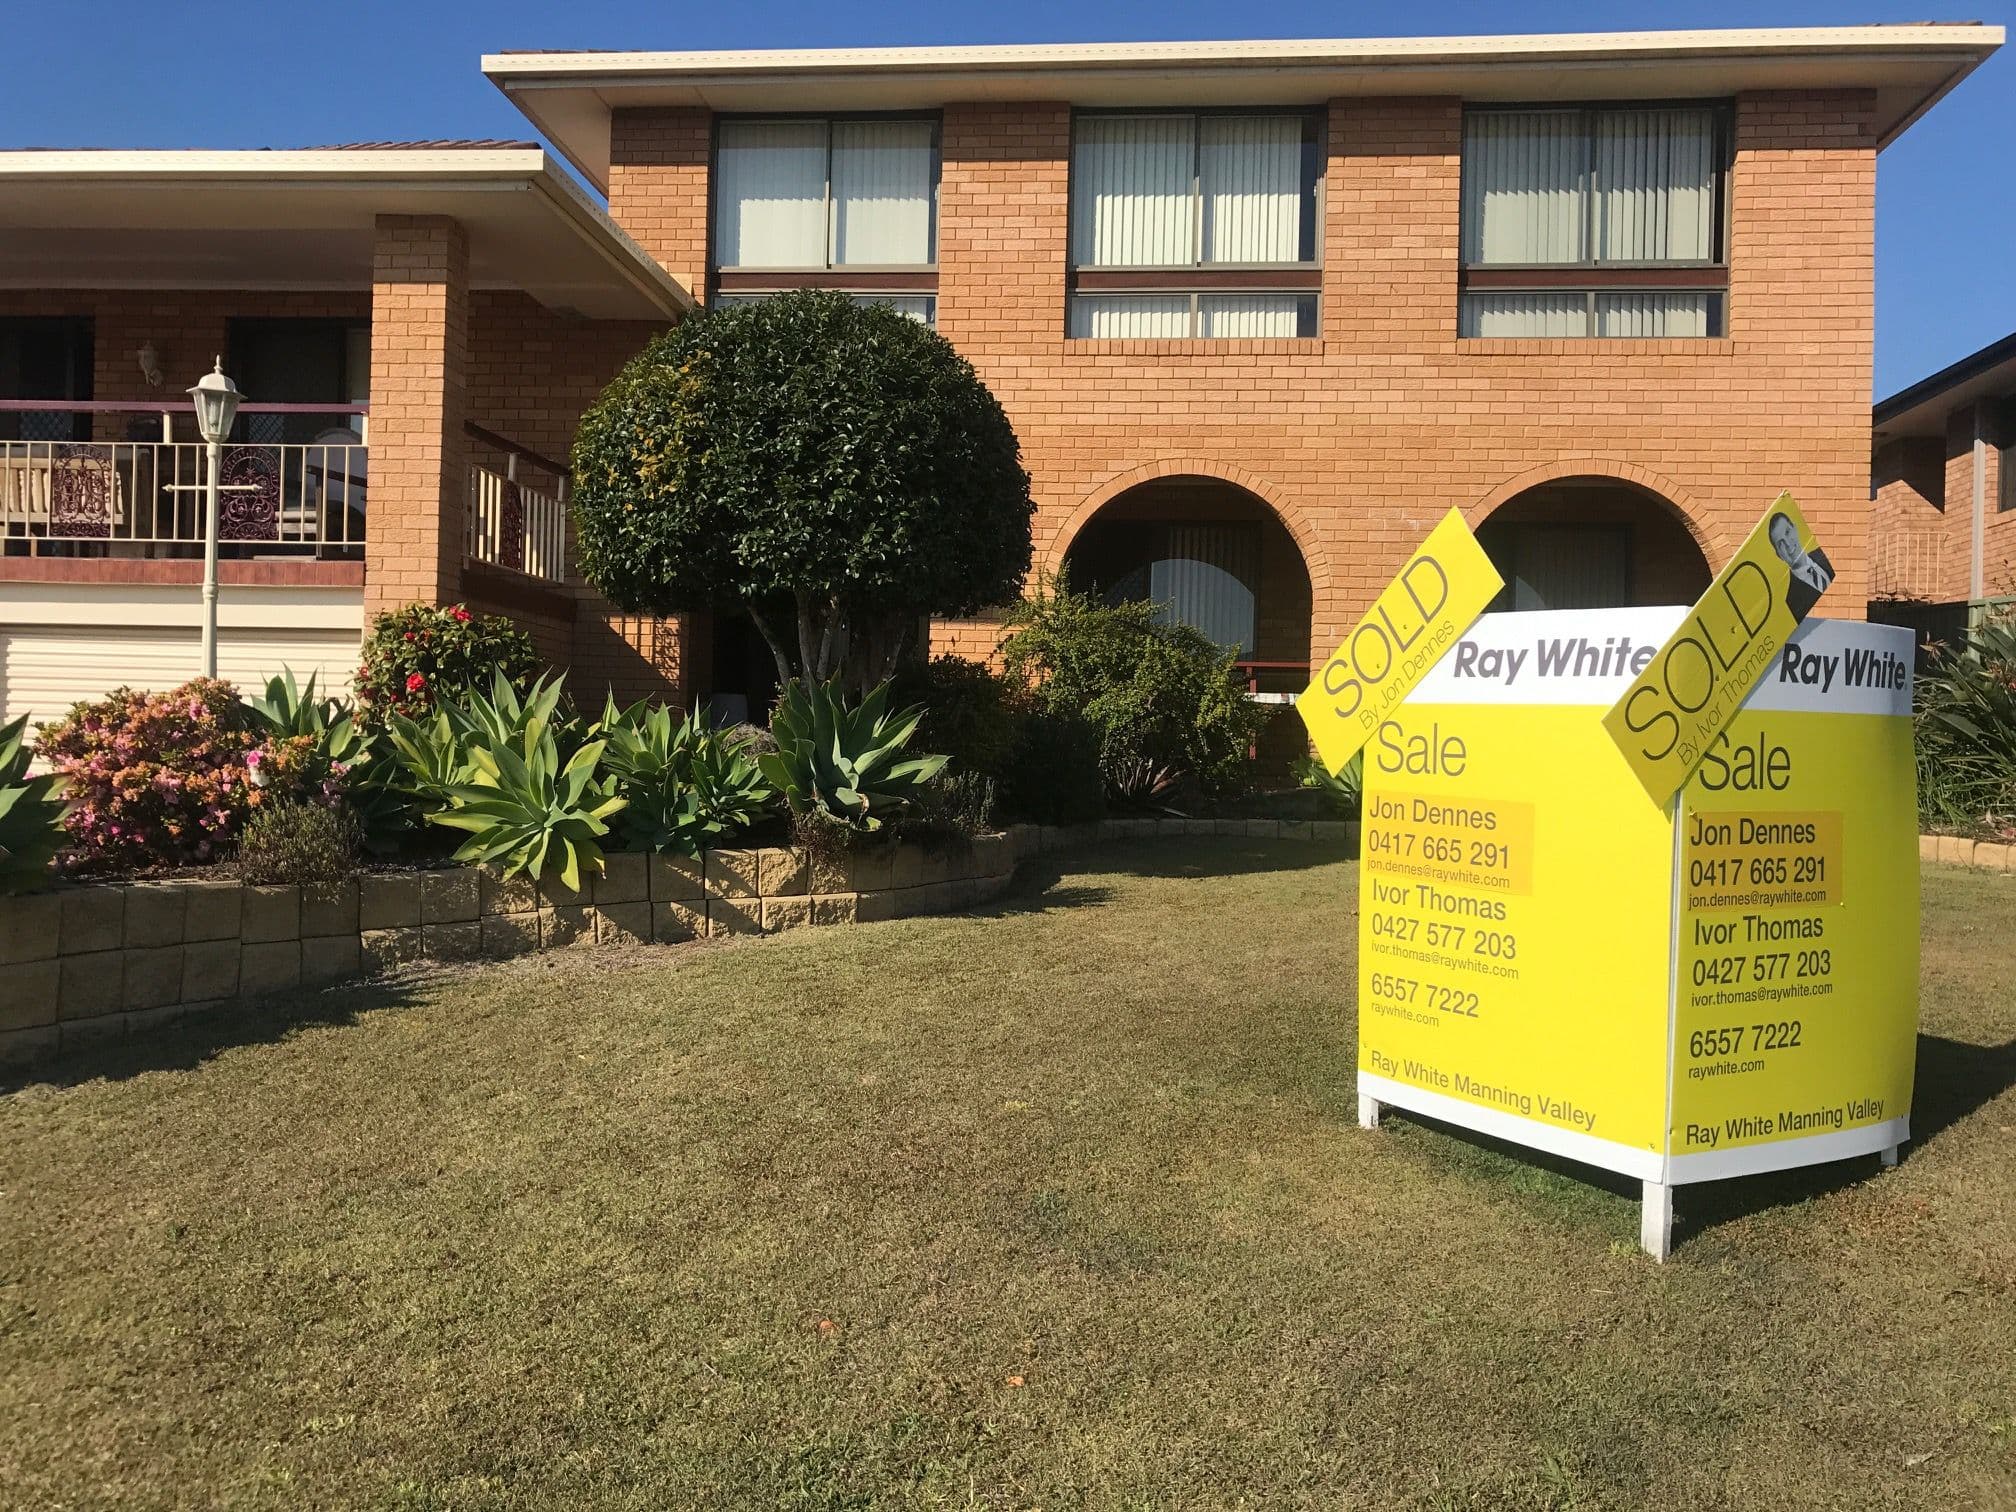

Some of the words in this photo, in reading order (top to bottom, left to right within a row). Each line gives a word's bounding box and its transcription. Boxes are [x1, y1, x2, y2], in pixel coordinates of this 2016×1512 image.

[1323, 555, 1449, 719] SOLD
[1358, 709, 1379, 731] By
[1381, 672, 1405, 710] Jon
[1401, 620, 1455, 682] Dennes
[1454, 641, 1529, 685] Ray
[1537, 637, 1658, 677] White
[1625, 561, 1772, 761] SOLD
[1779, 643, 1839, 693] Ray
[1676, 734, 1703, 767] By
[1696, 706, 1723, 743] Ivor
[1719, 635, 1775, 703] Thomas
[1377, 720, 1467, 777] Sale
[1699, 731, 1791, 791] Sale
[1369, 795, 1406, 821] Jon
[1412, 798, 1498, 831] Dennes
[1690, 818, 1732, 847] Jon
[1738, 817, 1816, 846] Dennes
[1368, 829, 1416, 858] 0417
[1422, 835, 1463, 864] 665
[1469, 842, 1510, 870] 291
[1367, 857, 1511, 890] jon.dennes@raywhite.com
[1690, 858, 1744, 888] 0417
[1749, 857, 1788, 886] 665
[1793, 855, 1826, 883] 291
[1372, 878, 1411, 906] Ivor
[1415, 884, 1507, 922] Thomas
[1687, 888, 1827, 912] jon.dennes@raywhite.com
[1371, 912, 1420, 943] 0427
[1426, 922, 1467, 951] 577
[1473, 929, 1517, 961] 203
[1694, 917, 1738, 946] Ivor
[1742, 914, 1824, 943] Thomas
[1370, 940, 1520, 981] ivor.thomas@raywhite.com
[1692, 956, 1747, 987] 0427
[1752, 952, 1791, 982] 577
[1796, 949, 1832, 978] 203
[1370, 1000, 1441, 1028] raywhite.com
[1371, 972, 1419, 1004] 6557
[1425, 983, 1480, 1018] 7222
[1690, 982, 1834, 1008] ivor.thomas@raywhite.com
[1689, 1026, 1745, 1059] 6557
[1751, 1020, 1802, 1052] 7222
[1687, 1057, 1765, 1081] raywhite.com
[1371, 1049, 1400, 1079] Ray
[1403, 1058, 1450, 1089] White
[1454, 1072, 1532, 1116] Manning
[1536, 1094, 1598, 1132] Valley
[1685, 1124, 1721, 1149] Ray
[1725, 1117, 1774, 1141] White
[1778, 1105, 1843, 1132] Manning
[1846, 1098, 1885, 1122] Valley
